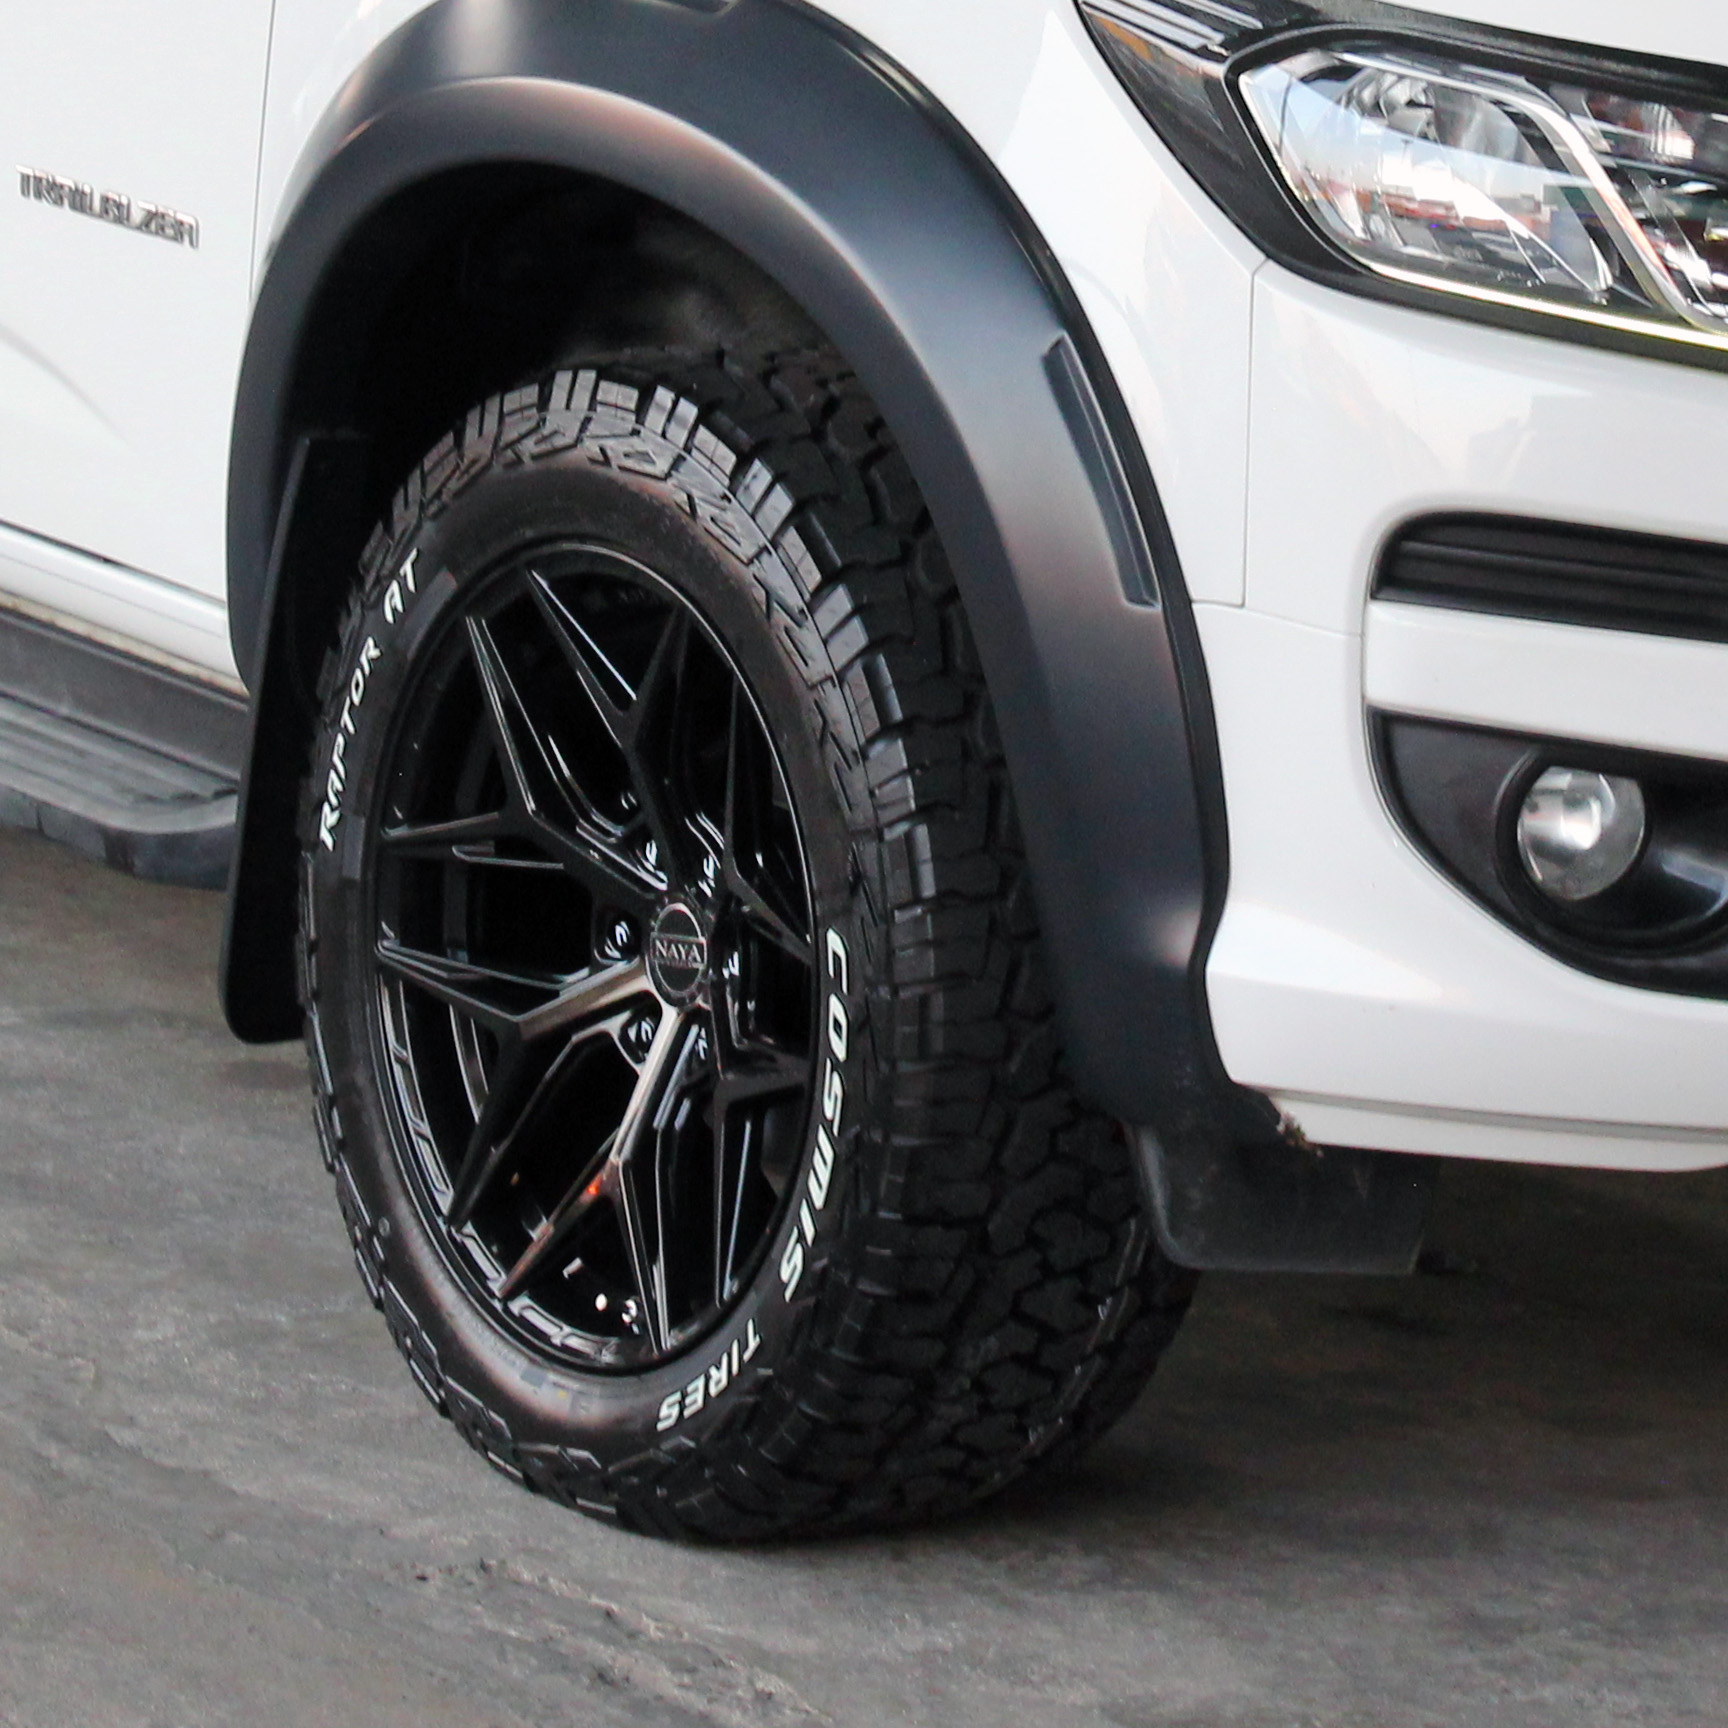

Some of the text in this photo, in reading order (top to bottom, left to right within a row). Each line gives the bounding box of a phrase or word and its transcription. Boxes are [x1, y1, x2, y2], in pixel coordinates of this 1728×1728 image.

[318, 635, 383, 853] RAPTOR
[654, 938, 703, 963] NAYA
[655, 927, 849, 1433] COSMIS TIRES
